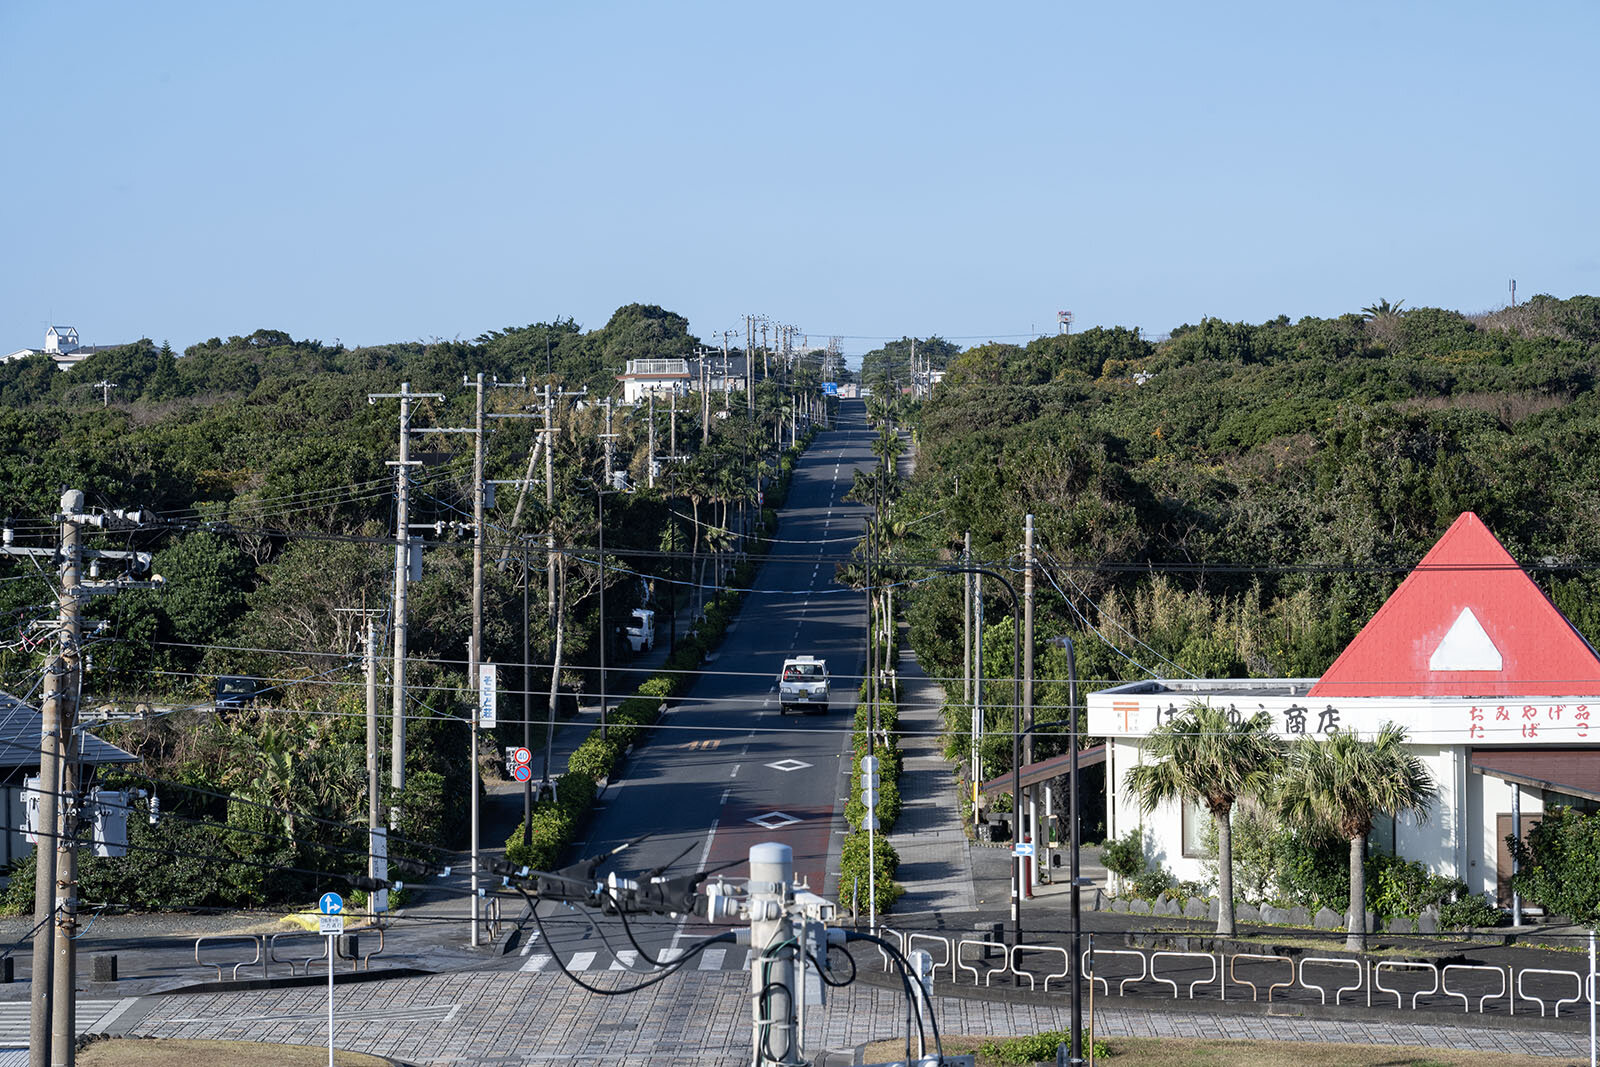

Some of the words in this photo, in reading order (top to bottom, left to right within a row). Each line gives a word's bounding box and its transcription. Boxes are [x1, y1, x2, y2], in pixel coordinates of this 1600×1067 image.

[1469, 704, 1591, 721] おみやげ品
[1469, 723, 1589, 738] たばこ
[518, 752, 528, 761] 40
